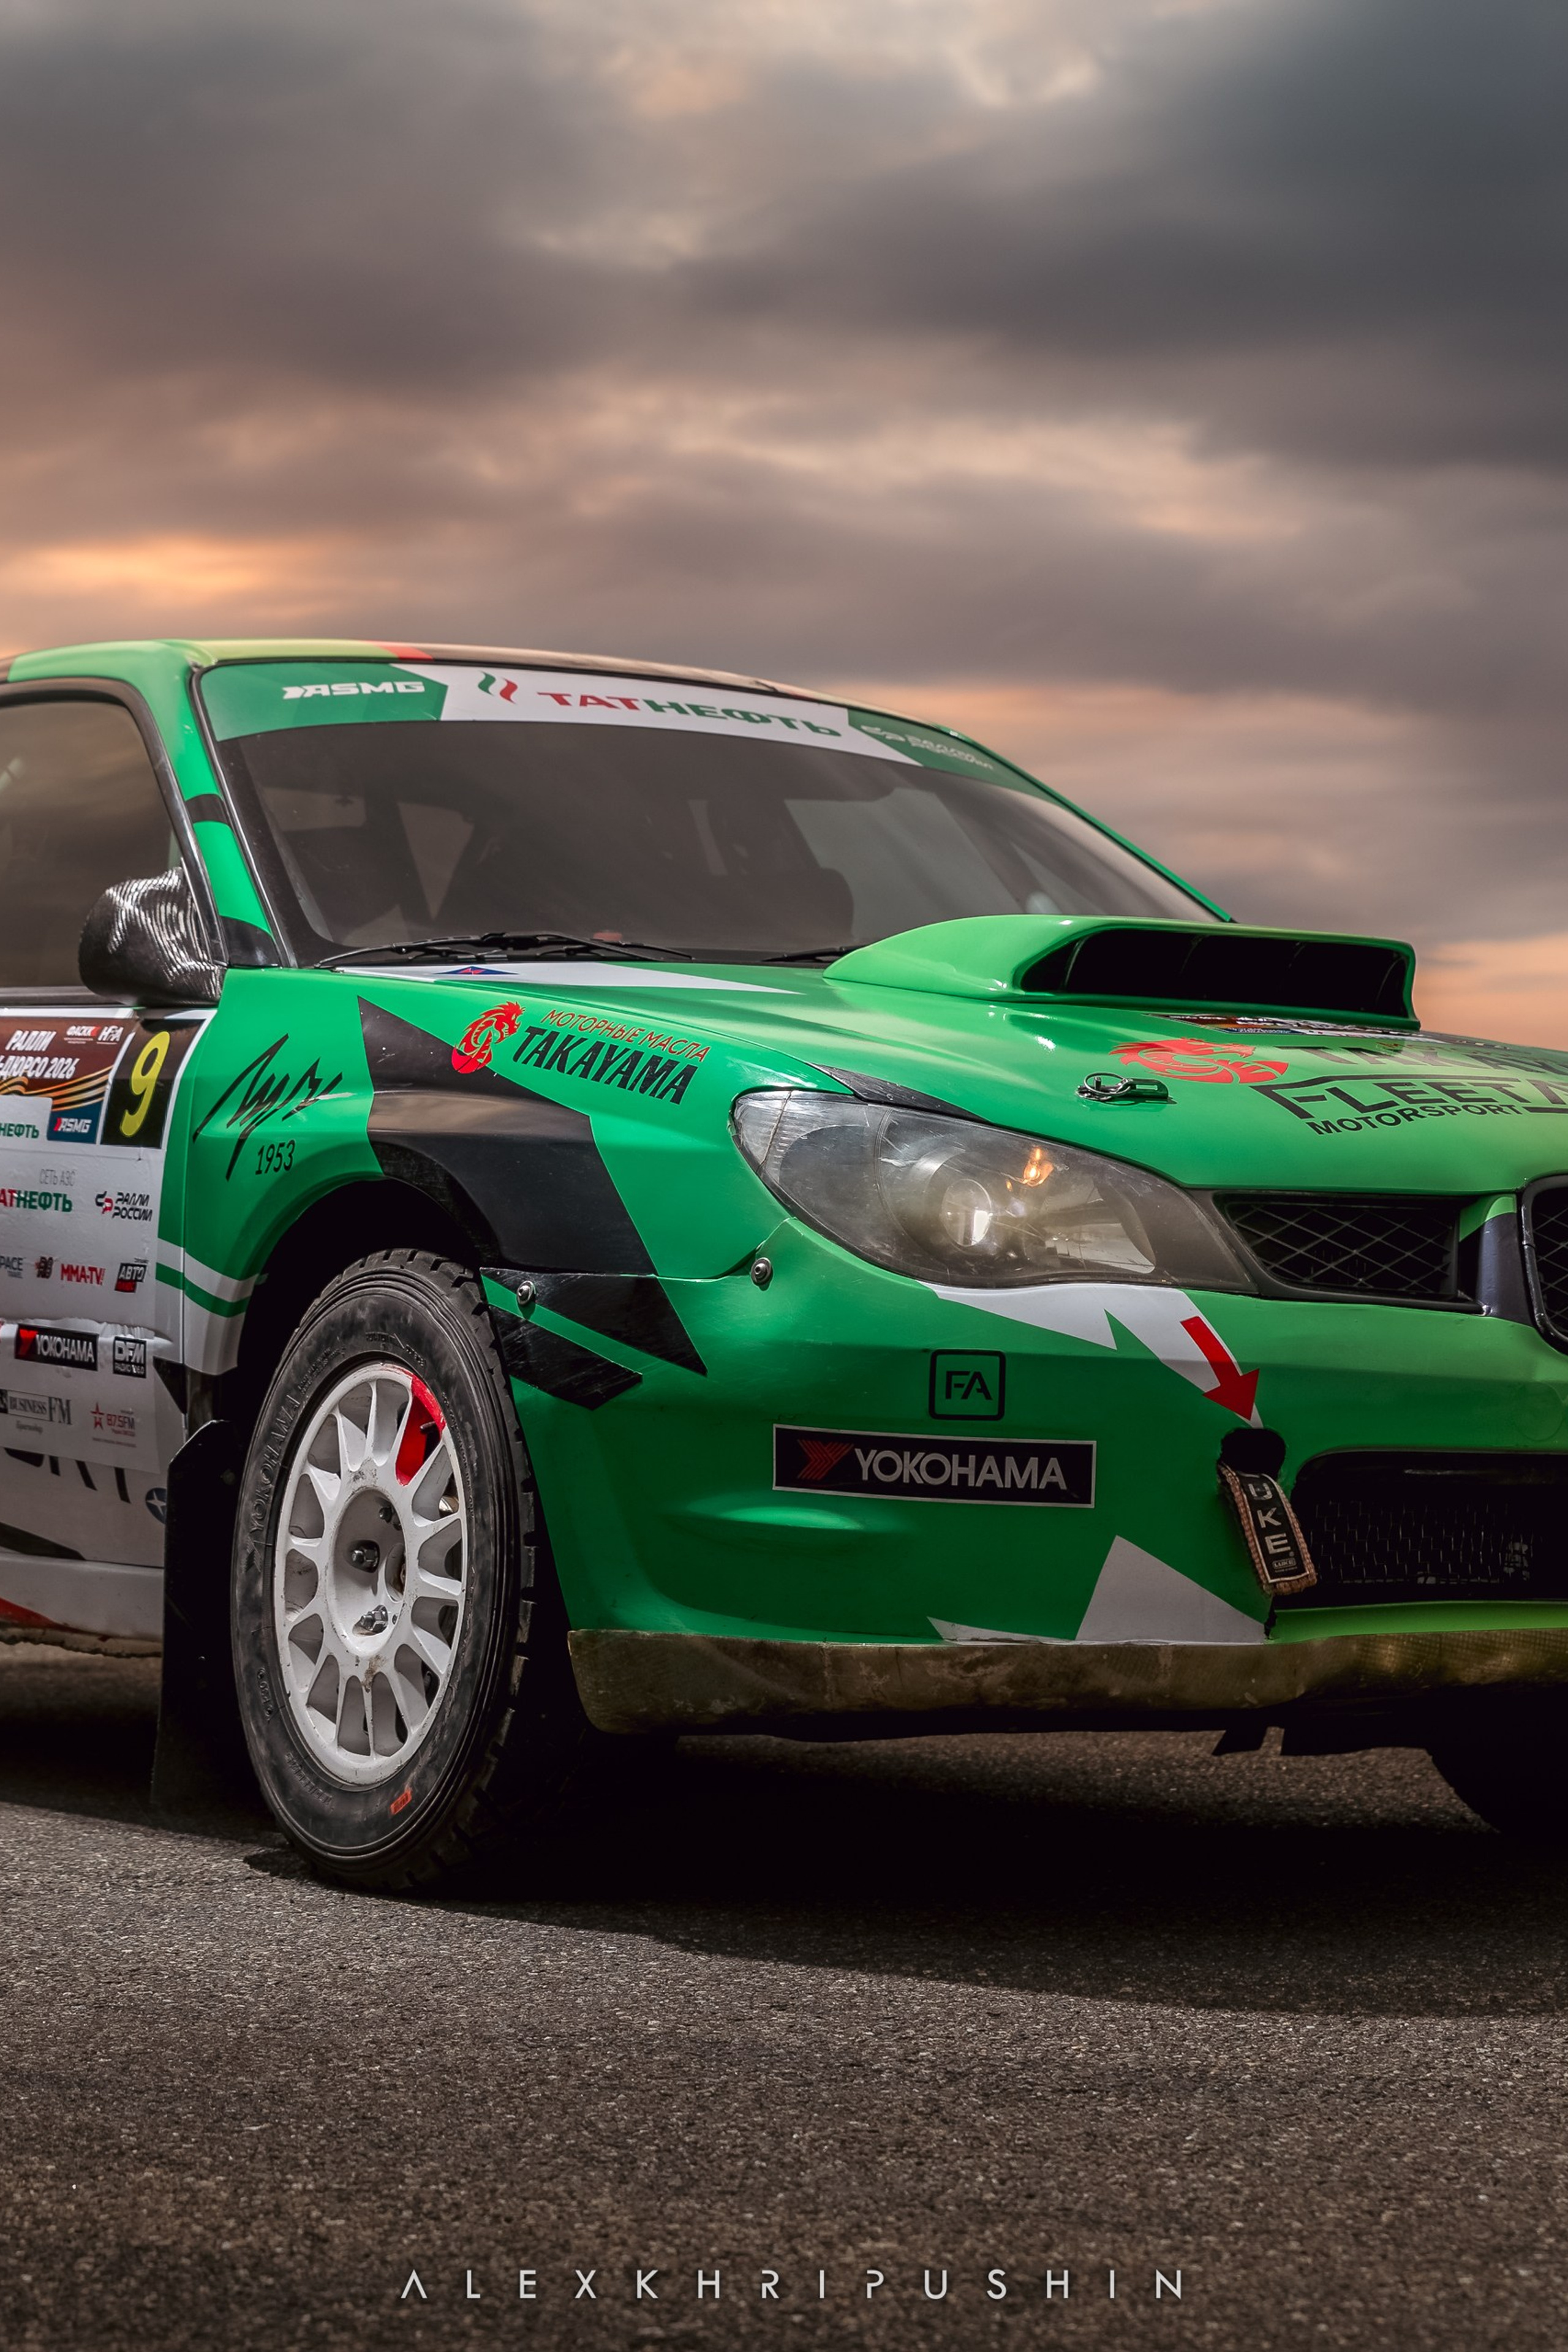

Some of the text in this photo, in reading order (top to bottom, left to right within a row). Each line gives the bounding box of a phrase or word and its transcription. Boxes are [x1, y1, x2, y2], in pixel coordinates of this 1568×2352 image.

[537, 692, 842, 737] ТАТНЕФТЬ
[5, 1030, 56, 1052] РАЛЛИ
[541, 1009, 711, 1063] МОТОРНЫЕ МАСЛА
[43, 1057, 80, 1079] 2026
[512, 1025, 699, 1105] TAKAYAMA
[1276, 1045, 1568, 1076] TAKAY
[119, 1031, 170, 1137] 9
[1305, 1104, 1523, 1135] MOTORSPORT
[255, 1139, 295, 1175] 1953
[39, 1169, 77, 1186] СЕТЬ АЗС
[112, 1207, 153, 1222] РОССИИ
[115, 1192, 149, 1207] РАЛЛИ
[119, 1265, 145, 1281] АВТО
[36, 1334, 94, 1363] YOKOHAMA
[115, 1340, 144, 1364] DFM
[945, 1370, 993, 1401] FA
[48, 1396, 72, 1425] FM
[249, 1394, 301, 1532] YOKOHAMA
[854, 1448, 1067, 1490] YOKOHAMA
